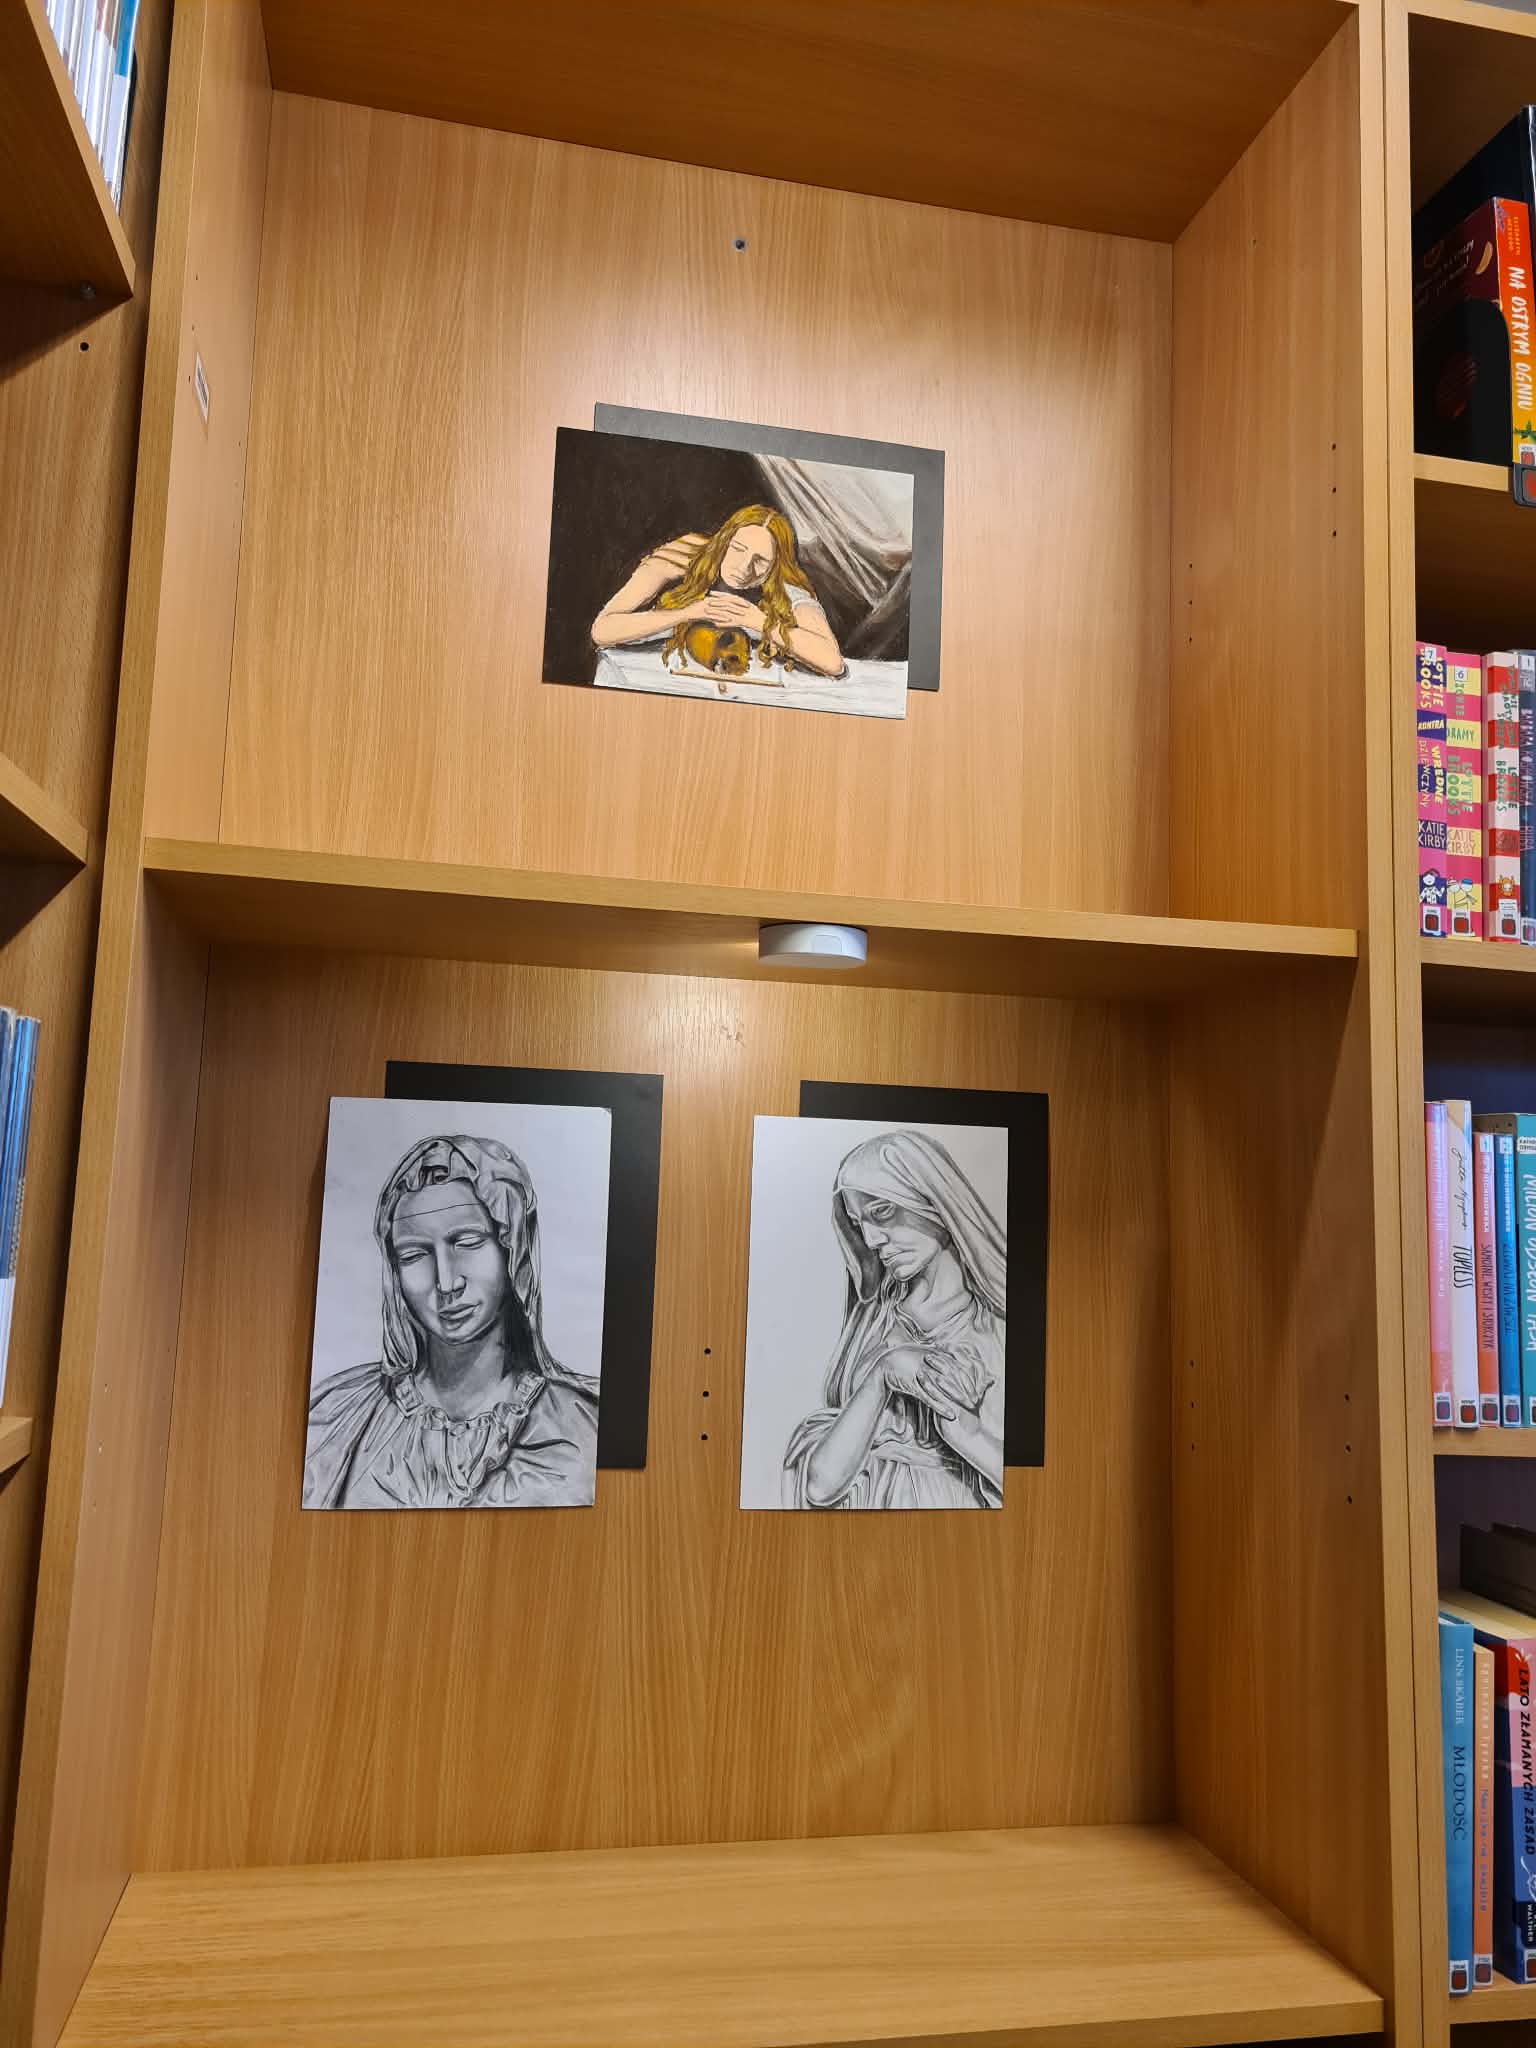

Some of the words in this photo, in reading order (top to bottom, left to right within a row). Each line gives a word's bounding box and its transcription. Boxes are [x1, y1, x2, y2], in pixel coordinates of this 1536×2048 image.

[1507, 266, 1527, 290] NA
[1511, 296, 1531, 356] OSTRYM
[1515, 362, 1534, 411] OGNIU
[1456, 670, 1465, 680] 6
[1419, 740, 1431, 808] DZIEWCZYNY
[1431, 745, 1445, 805] WREDNE
[1447, 755, 1460, 815] BROOKS
[1460, 762, 1473, 813] LOTTIE
[1496, 761, 1507, 812] BROOKS
[1507, 767, 1518, 809] LOTTIE
[1418, 821, 1445, 835] KATIE
[1418, 834, 1446, 849] KIRBY
[1523, 1174, 1536, 1229] MILION
[1452, 1244, 1473, 1289] TOPLESS
[1455, 1648, 1465, 1676] LINN
[1519, 1668, 1530, 1706] LATO
[1520, 1711, 1534, 1802] ZŁAMANYCH
[1524, 1807, 1535, 1855] ZASAD
